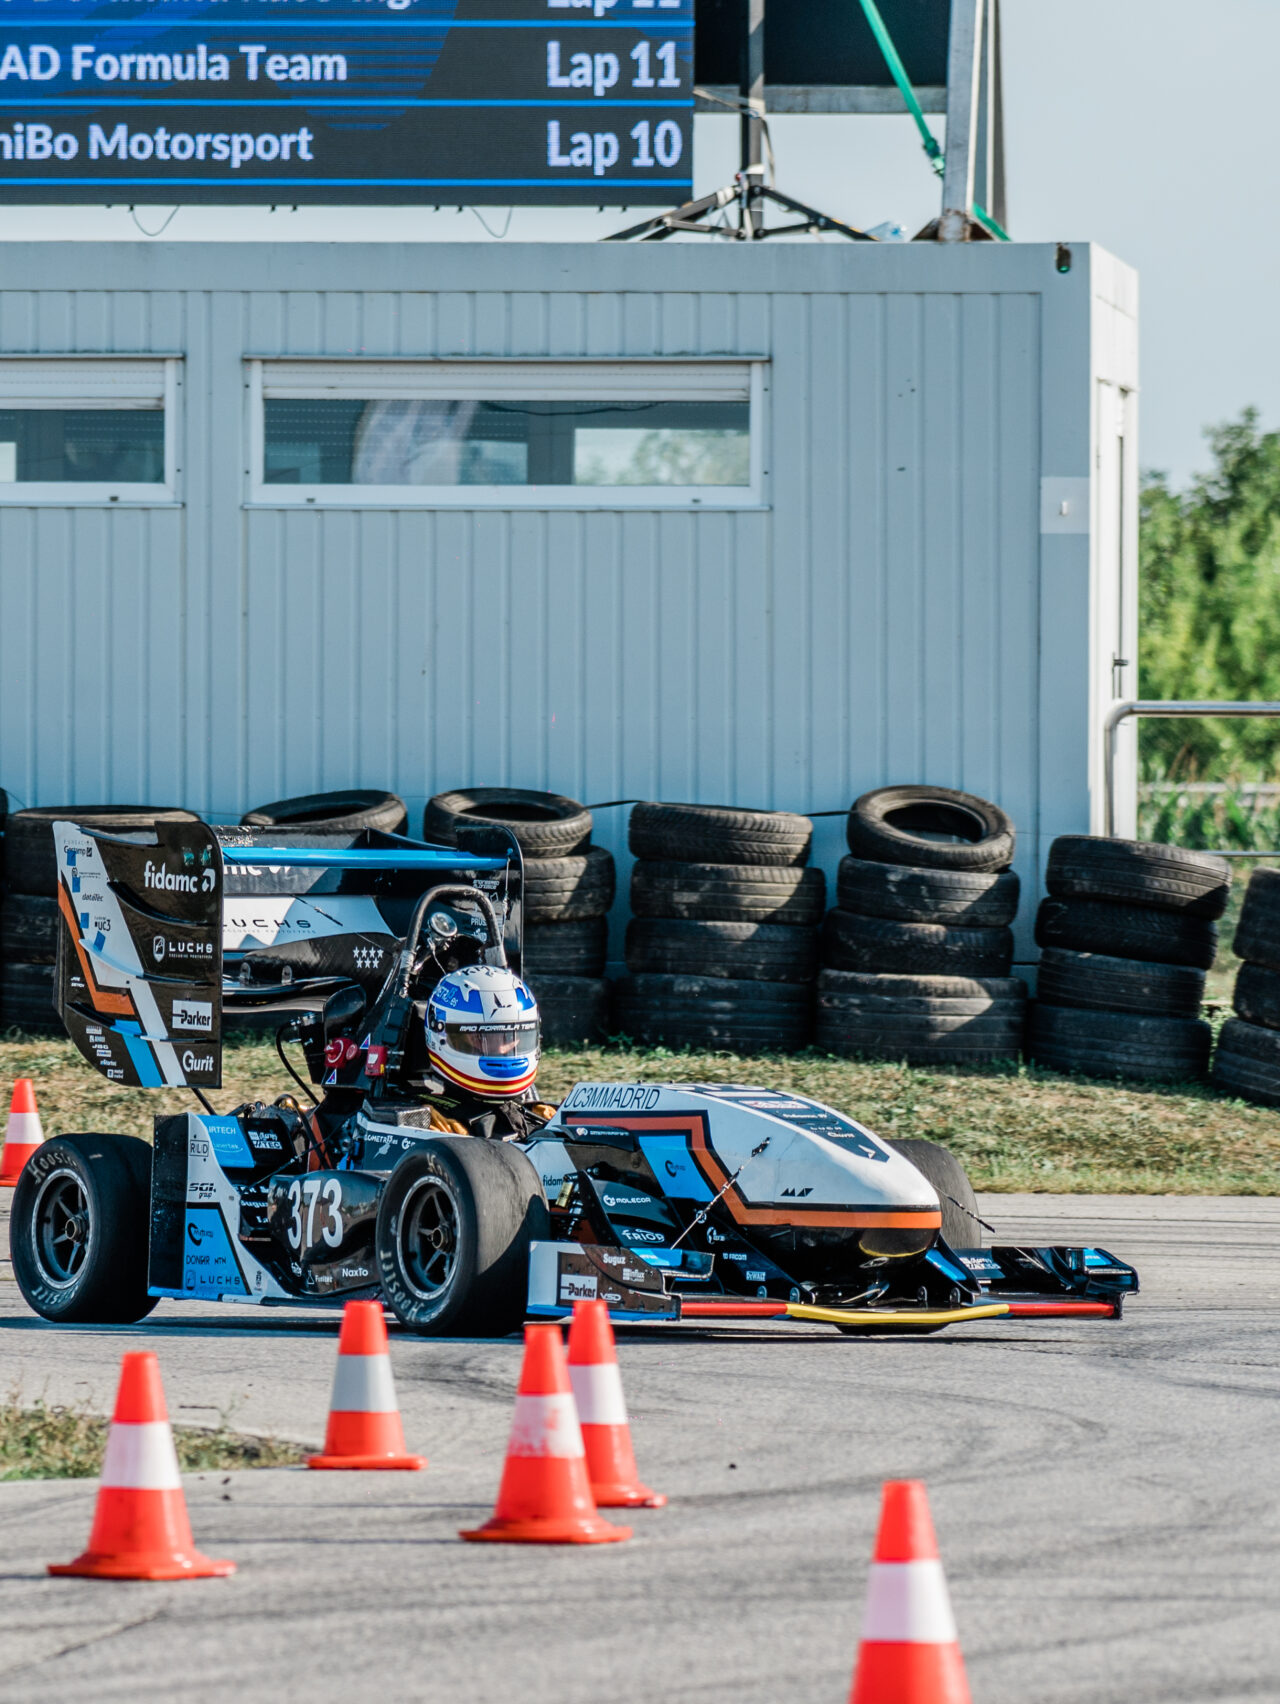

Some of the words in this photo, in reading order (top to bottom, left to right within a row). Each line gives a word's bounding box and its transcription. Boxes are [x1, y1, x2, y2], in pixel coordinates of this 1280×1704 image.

[72, 44, 229, 81] Formula
[239, 44, 348, 81] Team
[547, 40, 619, 96] Lap
[630, 40, 681, 87] 11
[88, 123, 314, 168] Motorsport
[547, 120, 619, 175] Lap
[630, 119, 683, 168] 10
[144, 860, 198, 893] fidamc
[223, 918, 311, 928] UCHS
[169, 942, 213, 953] LUCHS
[180, 1009, 211, 1027] Parker
[182, 1050, 214, 1072] Gurit
[563, 1086, 660, 1110] UC3MMADRID
[542, 1175, 564, 1187] fidam
[287, 1178, 343, 1250] 373
[200, 1274, 241, 1285] LUCHS
[568, 1282, 596, 1298] Parker
